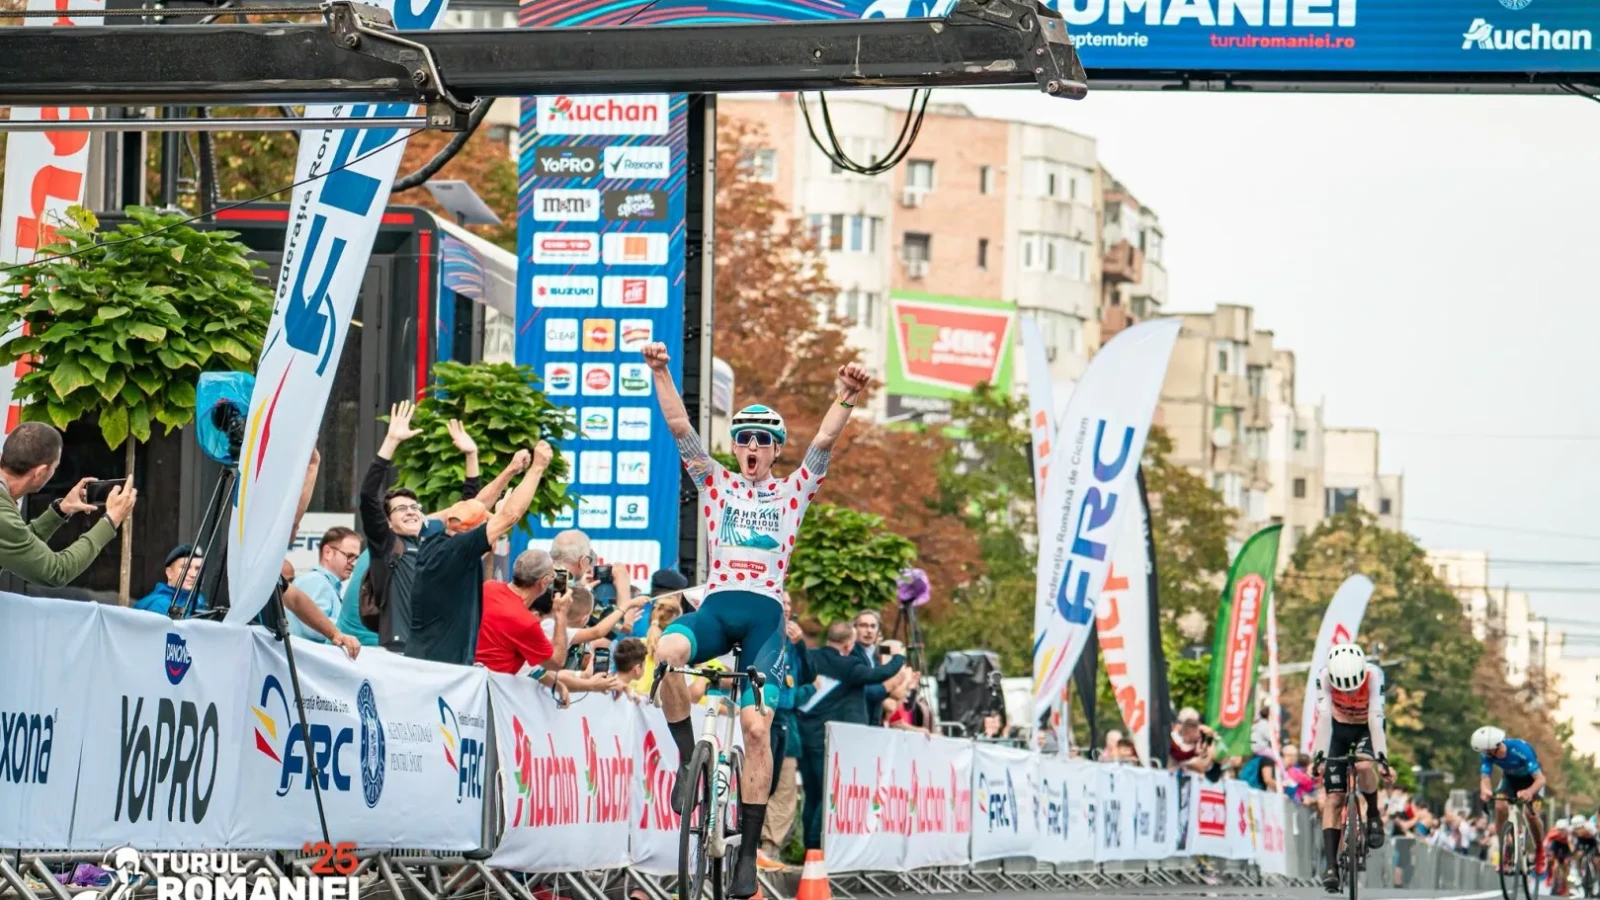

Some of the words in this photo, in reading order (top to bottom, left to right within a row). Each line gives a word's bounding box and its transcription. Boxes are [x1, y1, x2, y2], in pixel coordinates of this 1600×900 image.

[1070, 31, 1149, 49] eptembrie
[1210, 33, 1356, 49] turulromaniei.ro
[1461, 17, 1593, 51] Auchan
[549, 95, 658, 122] Auchan
[540, 156, 596, 173] YoPRO
[550, 287, 594, 296] SUZUKI
[547, 329, 576, 341] CLEAR
[726, 506, 780, 521] BAHRAIN
[1056, 418, 1135, 627] FRC
[166, 643, 191, 664] DANONE
[0, 711, 53, 784] xona
[114, 695, 219, 824] YoPRO
[276, 722, 354, 797] FRC
[457, 737, 484, 804] FRC
[512, 714, 579, 828] Auchan
